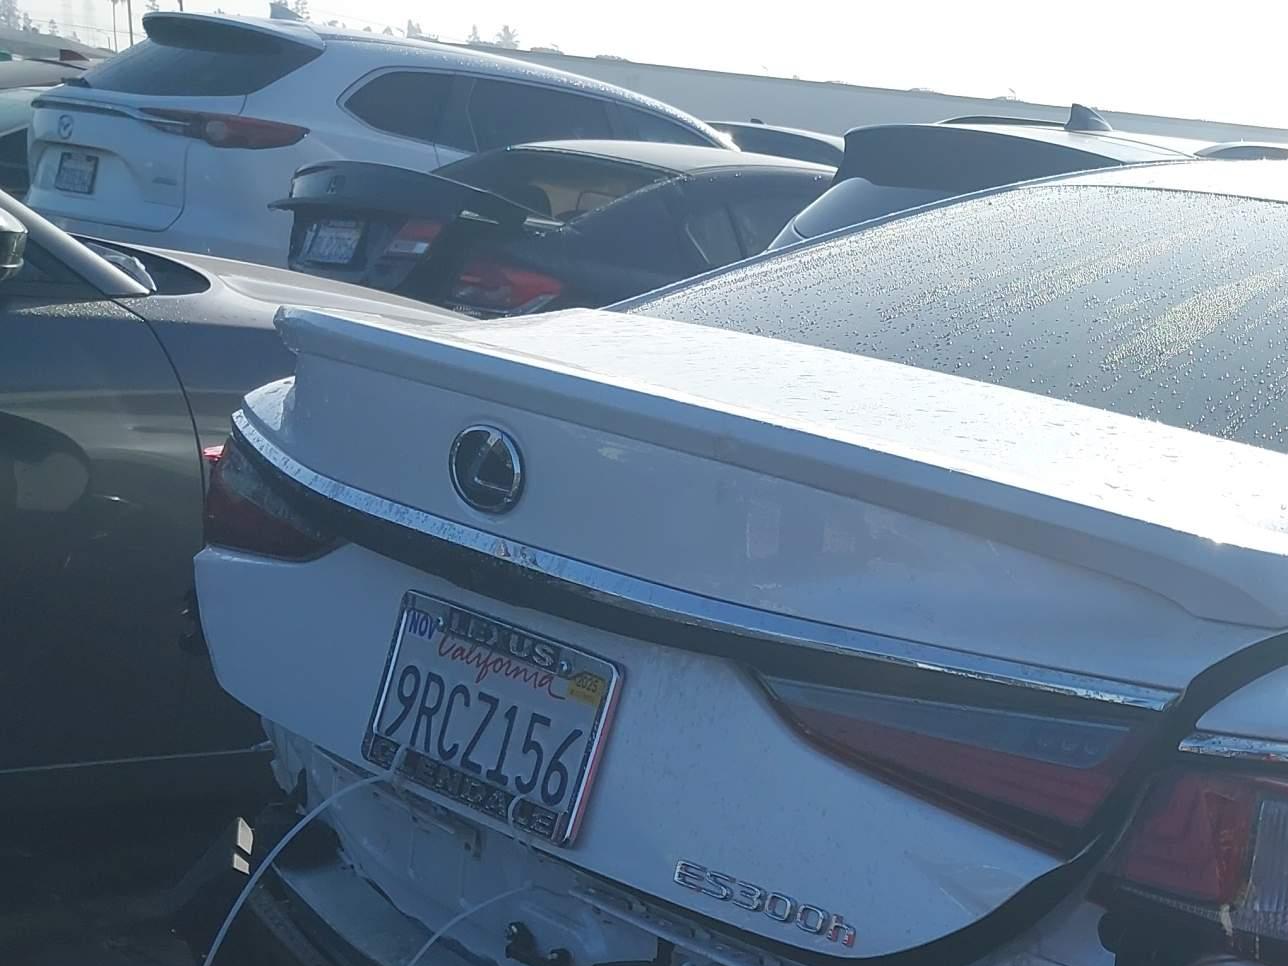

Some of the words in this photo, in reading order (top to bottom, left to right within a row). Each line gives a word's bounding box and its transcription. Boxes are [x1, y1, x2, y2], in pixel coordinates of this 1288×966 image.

[408, 610, 437, 640] NOV
[438, 630, 566, 700] California
[575, 675, 599, 694] 2025
[384, 665, 583, 806] 9RCZ156
[673, 859, 856, 948] ES300h
